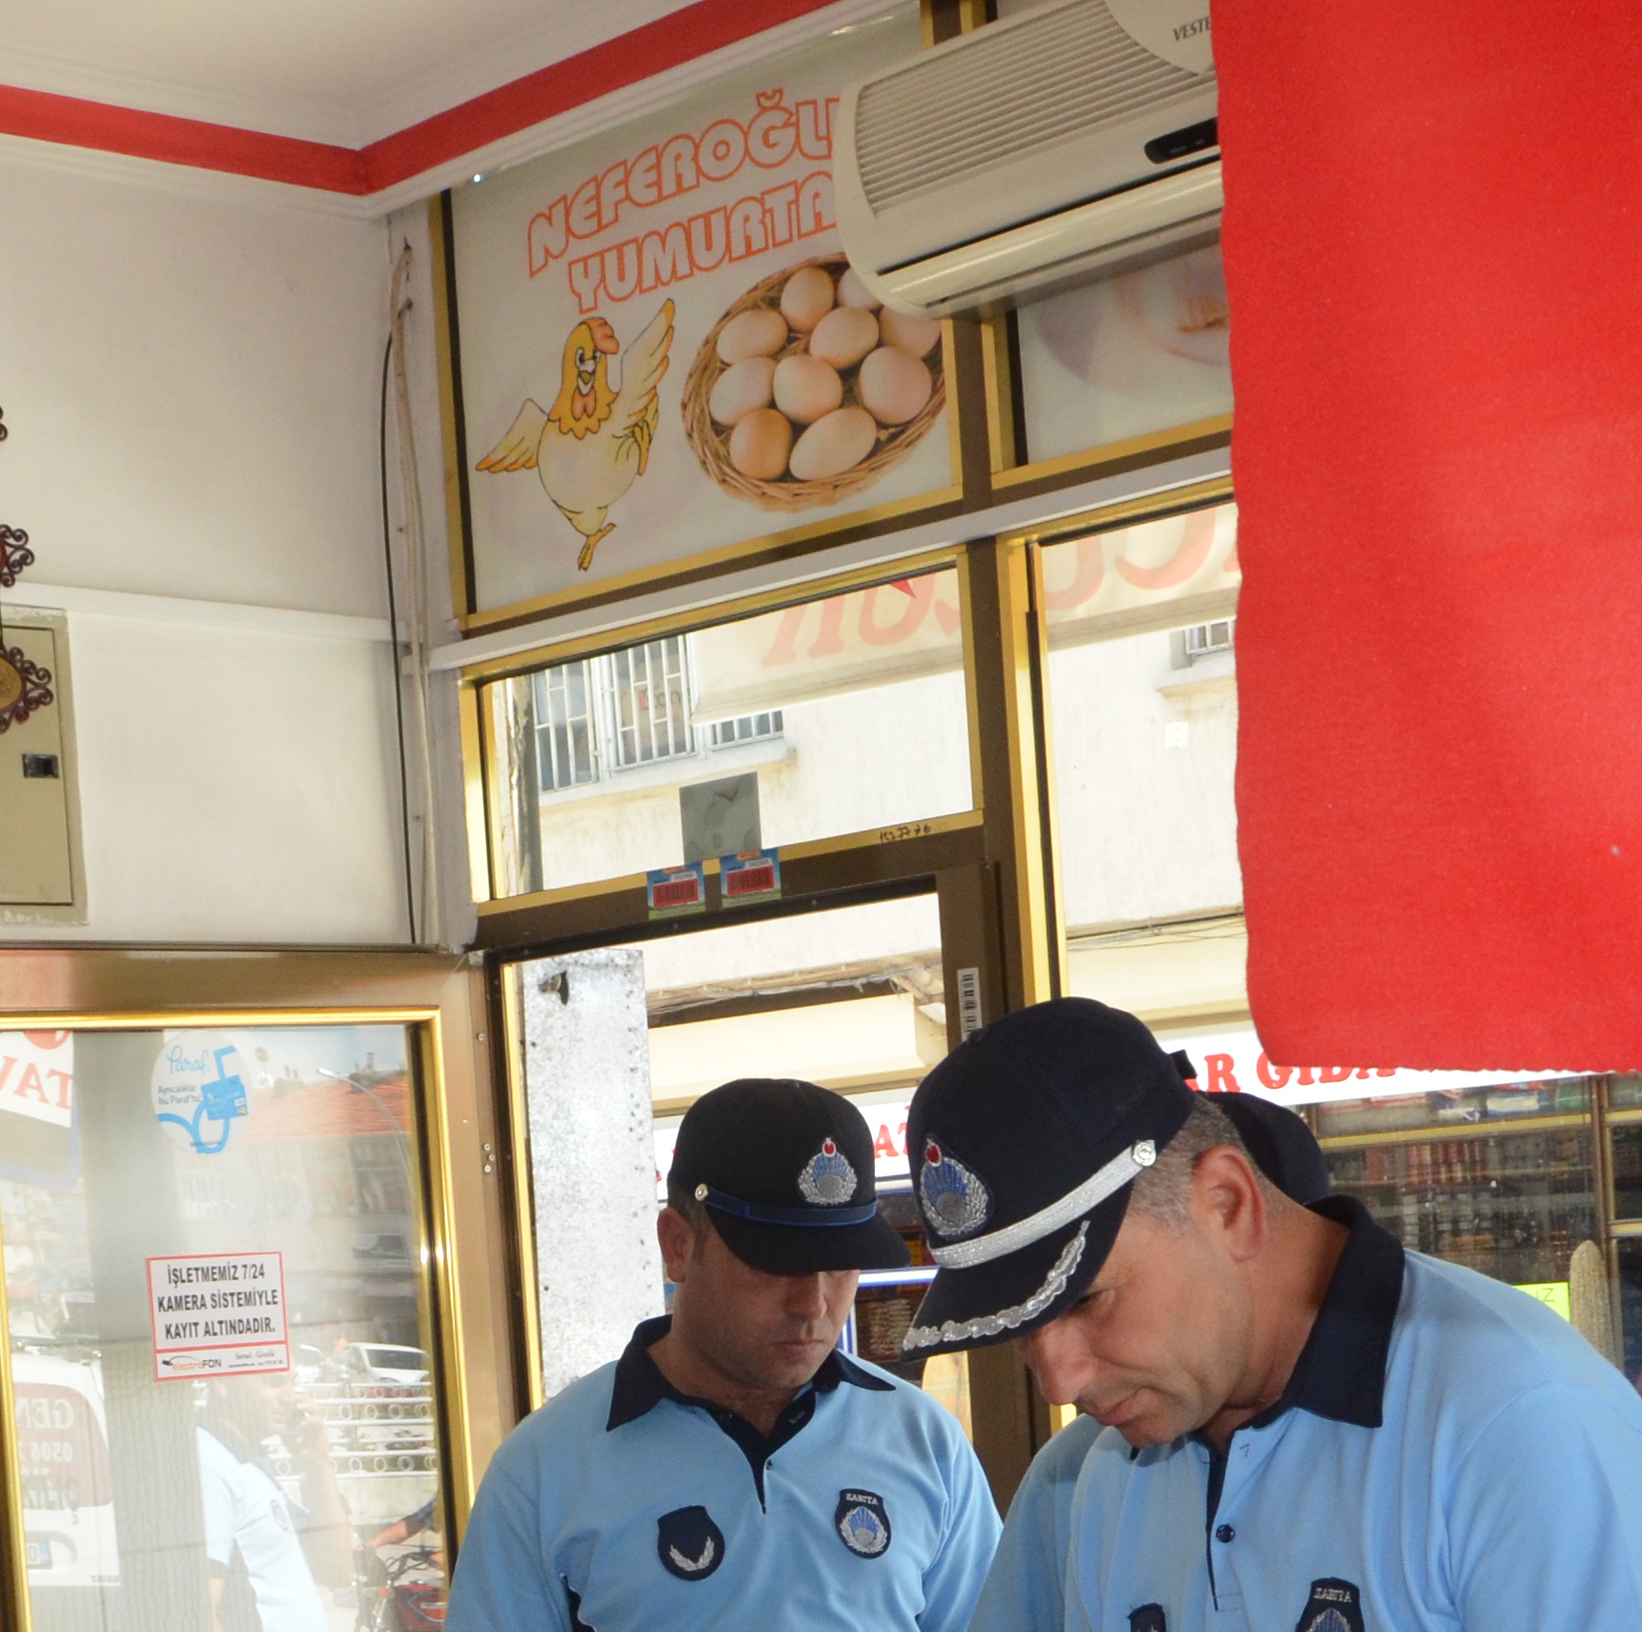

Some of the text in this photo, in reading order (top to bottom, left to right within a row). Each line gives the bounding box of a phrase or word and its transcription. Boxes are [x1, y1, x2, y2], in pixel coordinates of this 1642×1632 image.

[528, 88, 840, 278] NEFEROĞL
[569, 171, 837, 314] YUMURTA
[166, 1045, 209, 1076] Paraf
[167, 1262, 265, 1288] İŞLETMEMİZ 7/24
[157, 1287, 279, 1313] KAMERA SİSTEMİYLE
[165, 1317, 276, 1340] KAYIT ALTINDADIR.
[845, 1492, 879, 1506] ZABITA
[1314, 1587, 1352, 1604] ZABITA
